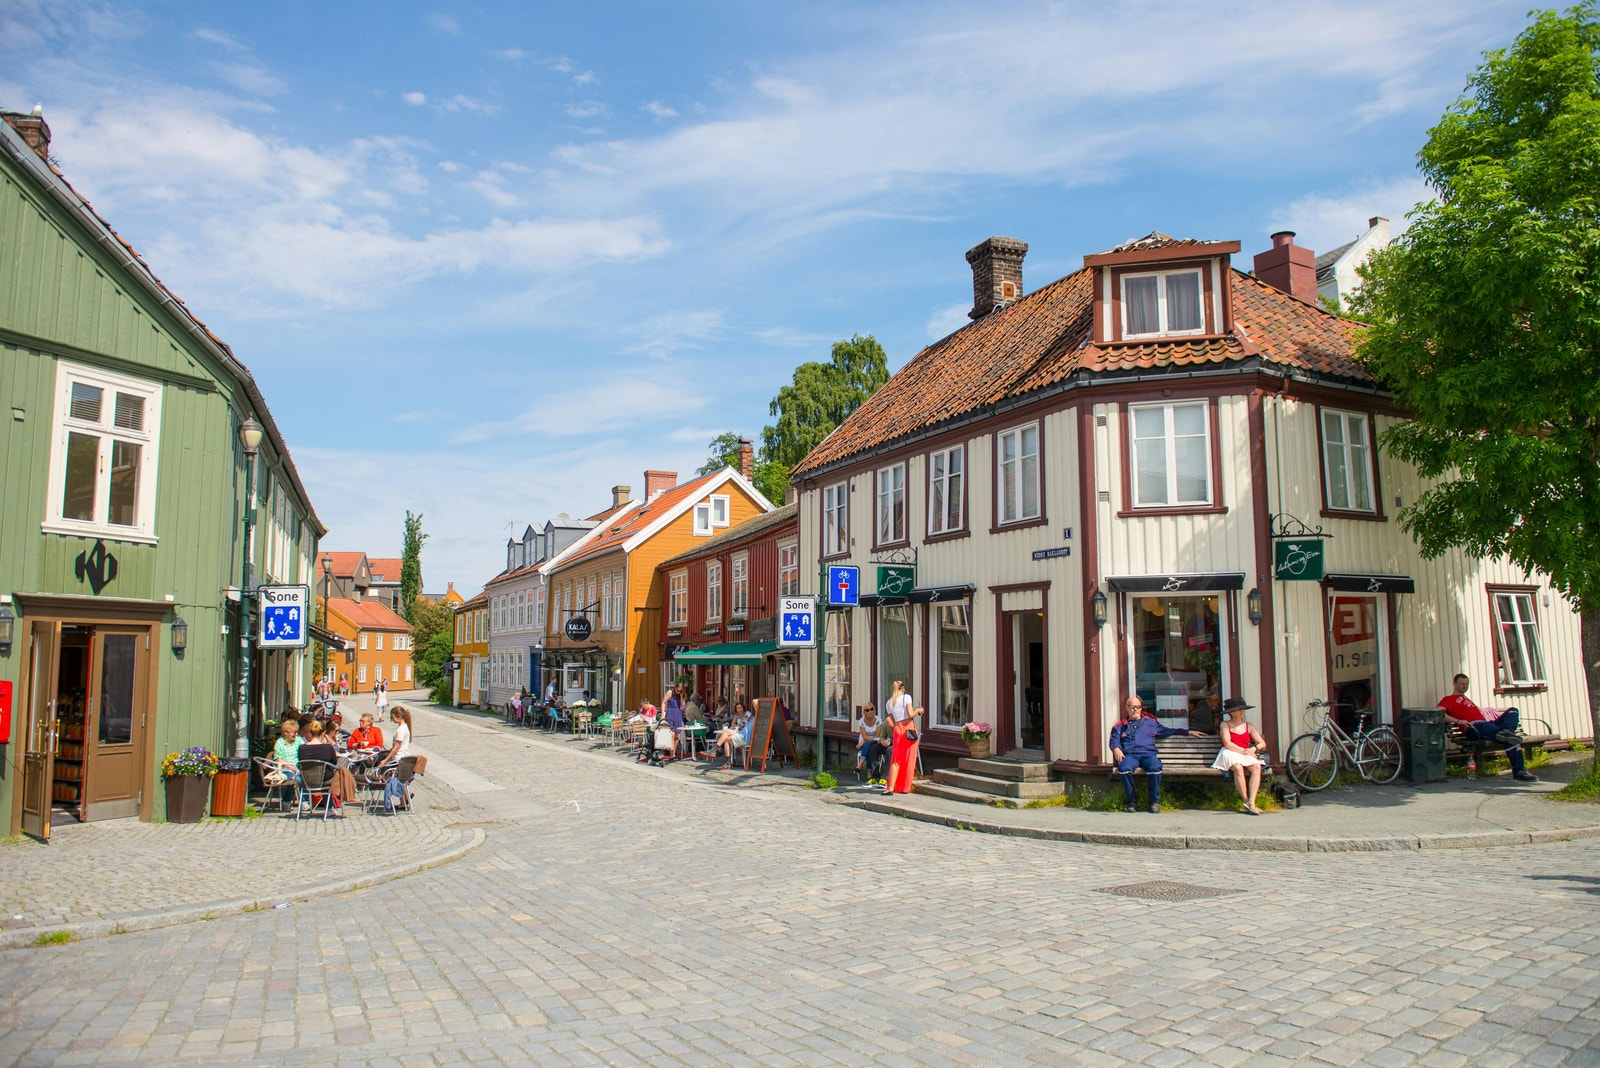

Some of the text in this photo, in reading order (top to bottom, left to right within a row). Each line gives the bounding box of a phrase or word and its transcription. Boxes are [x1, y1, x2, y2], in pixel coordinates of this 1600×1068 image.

[1277, 559, 1299, 572] Adam
[1306, 551, 1321, 559] Eva
[267, 591, 298, 602] Sone
[785, 600, 809, 610] Sone
